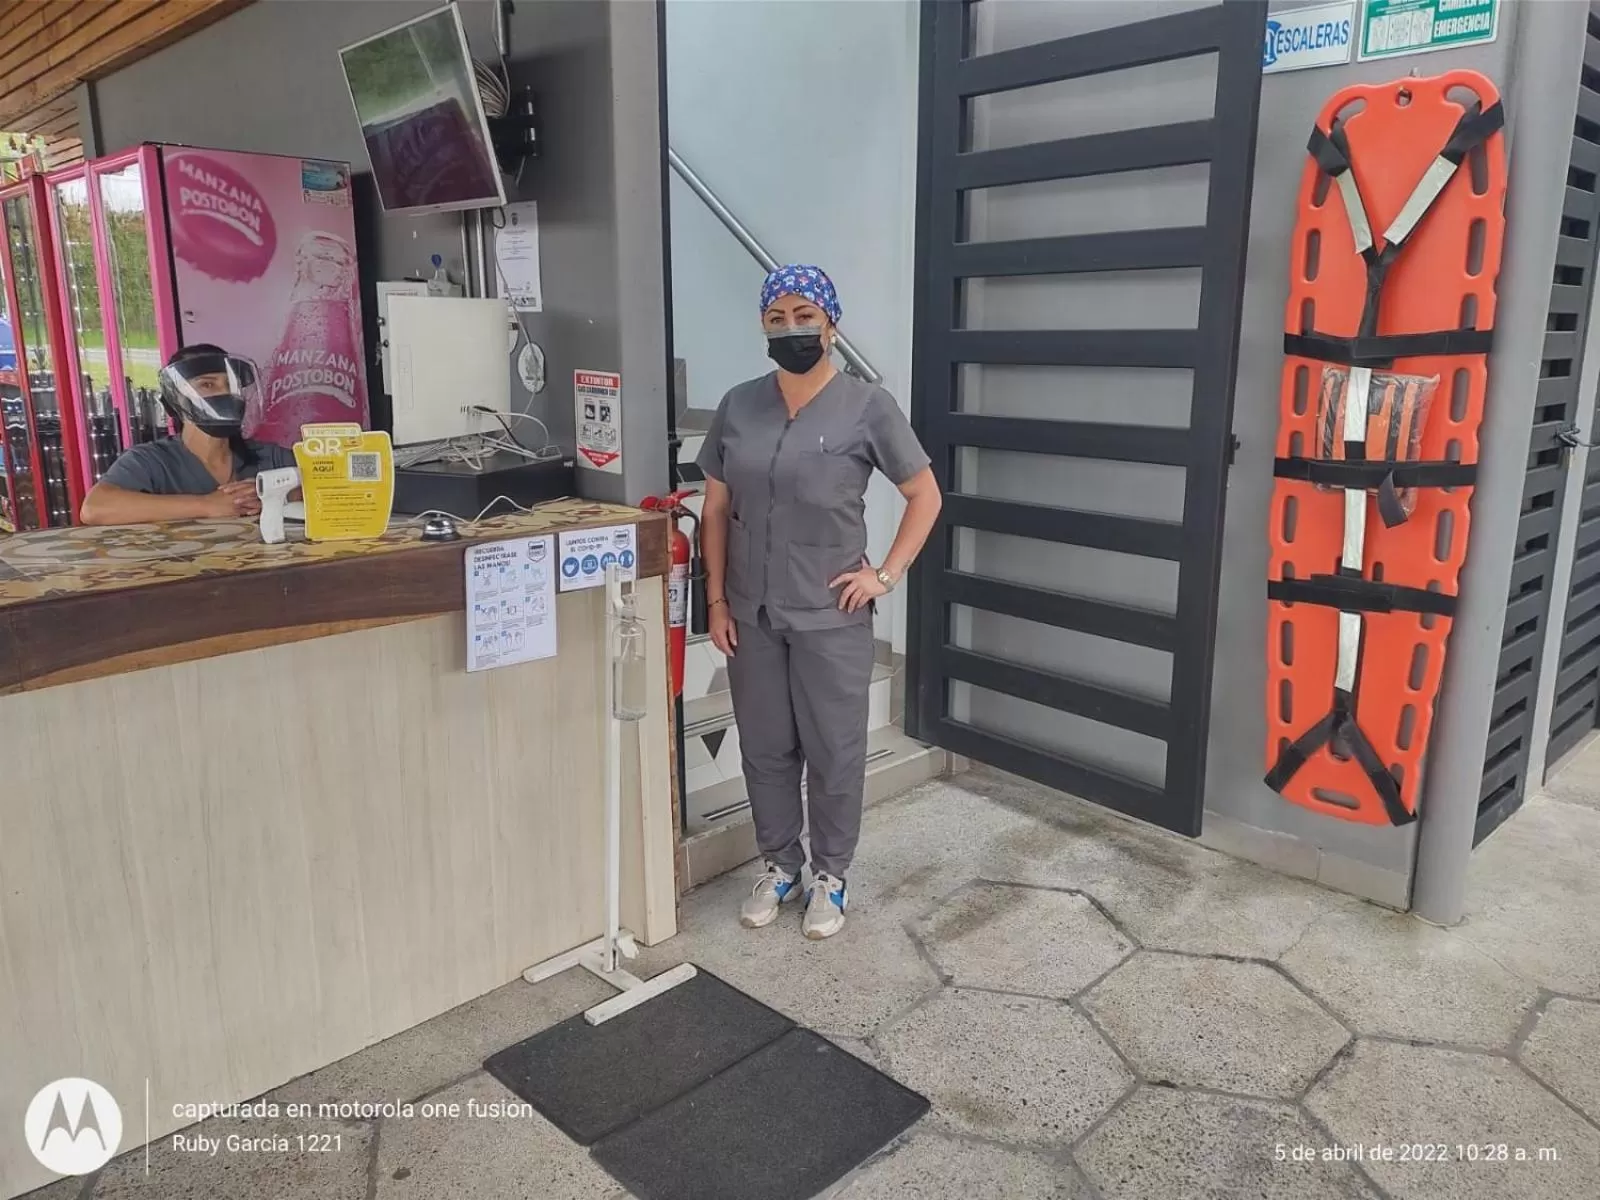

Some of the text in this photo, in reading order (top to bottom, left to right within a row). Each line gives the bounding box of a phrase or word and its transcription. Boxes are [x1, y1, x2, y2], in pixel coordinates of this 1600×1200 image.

[1276, 19, 1349, 53] ESCALERAS
[1434, 11, 1490, 38] EMERGENCIA
[179, 159, 263, 212] MANZANA
[180, 186, 261, 231] POSTOBON
[277, 349, 357, 376] MANZANA
[271, 368, 355, 402] POSTOBON
[580, 375, 614, 388] EXTINTOR
[303, 436, 343, 457] QR
